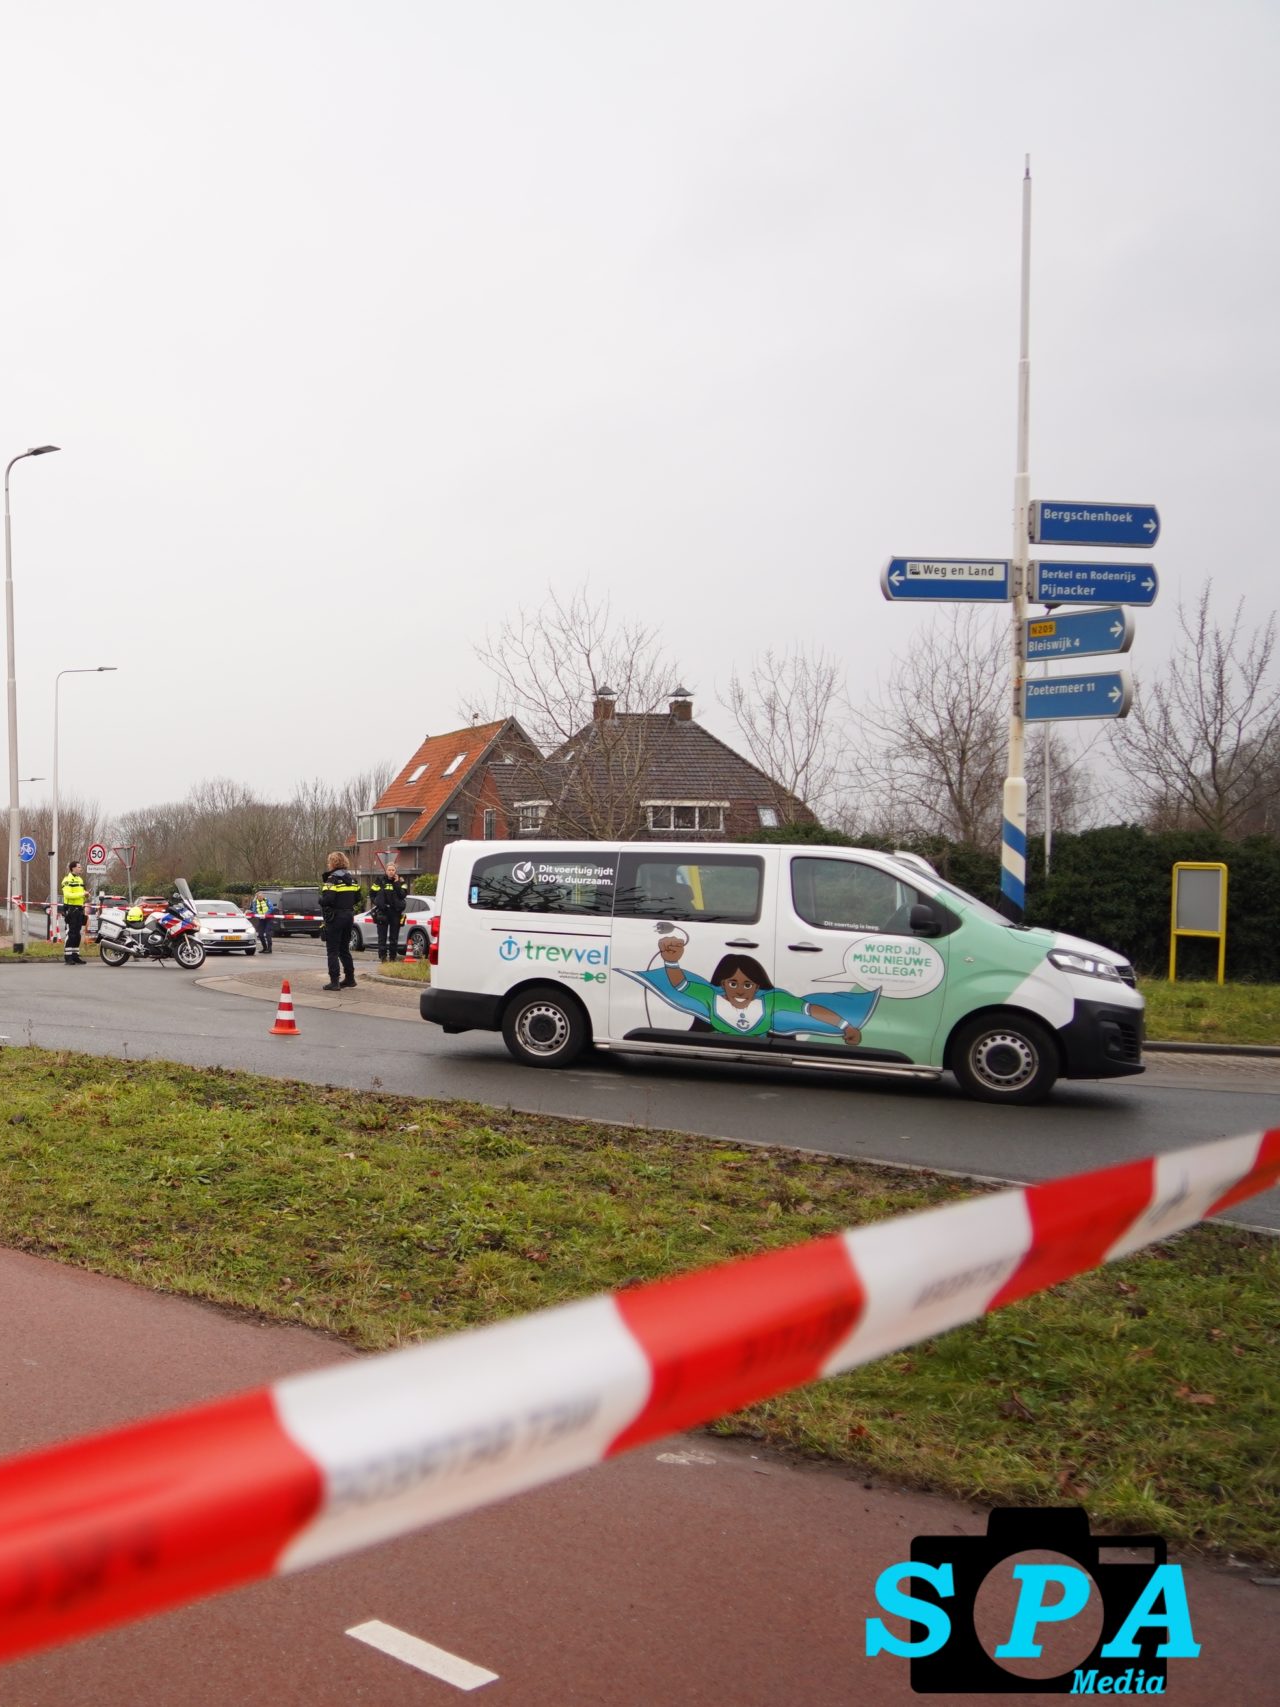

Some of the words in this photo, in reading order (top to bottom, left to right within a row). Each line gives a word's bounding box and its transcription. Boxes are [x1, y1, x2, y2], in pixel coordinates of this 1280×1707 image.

[1043, 508, 1133, 523] Bergschenhoek
[923, 564, 947, 578] Weg
[951, 567, 964, 576] en
[968, 566, 994, 576] Land
[1041, 569, 1073, 579] Berkel
[1075, 572, 1088, 580] en
[1090, 571, 1136, 583] Rodenrijs
[1041, 584, 1096, 597] Pijnacker
[1028, 637, 1072, 652] Bleiswijk
[1073, 638, 1080, 648] 4
[1027, 683, 1085, 696] Zoetermeer
[1086, 683, 1095, 692] 11
[91, 849, 103, 859] 50
[539, 865, 553, 873] Dit
[554, 866, 592, 875] voertuig
[594, 867, 614, 877] rijdt
[538, 874, 563, 884] 100%
[565, 875, 614, 886] duurzaam.
[525, 940, 609, 966] trevvel
[865, 943, 902, 954] WORD
[905, 946, 921, 956] JIJ
[853, 953, 880, 964] MIJN
[883, 955, 932, 967] NIEUWE
[860, 964, 924, 977] COLLEGA?
